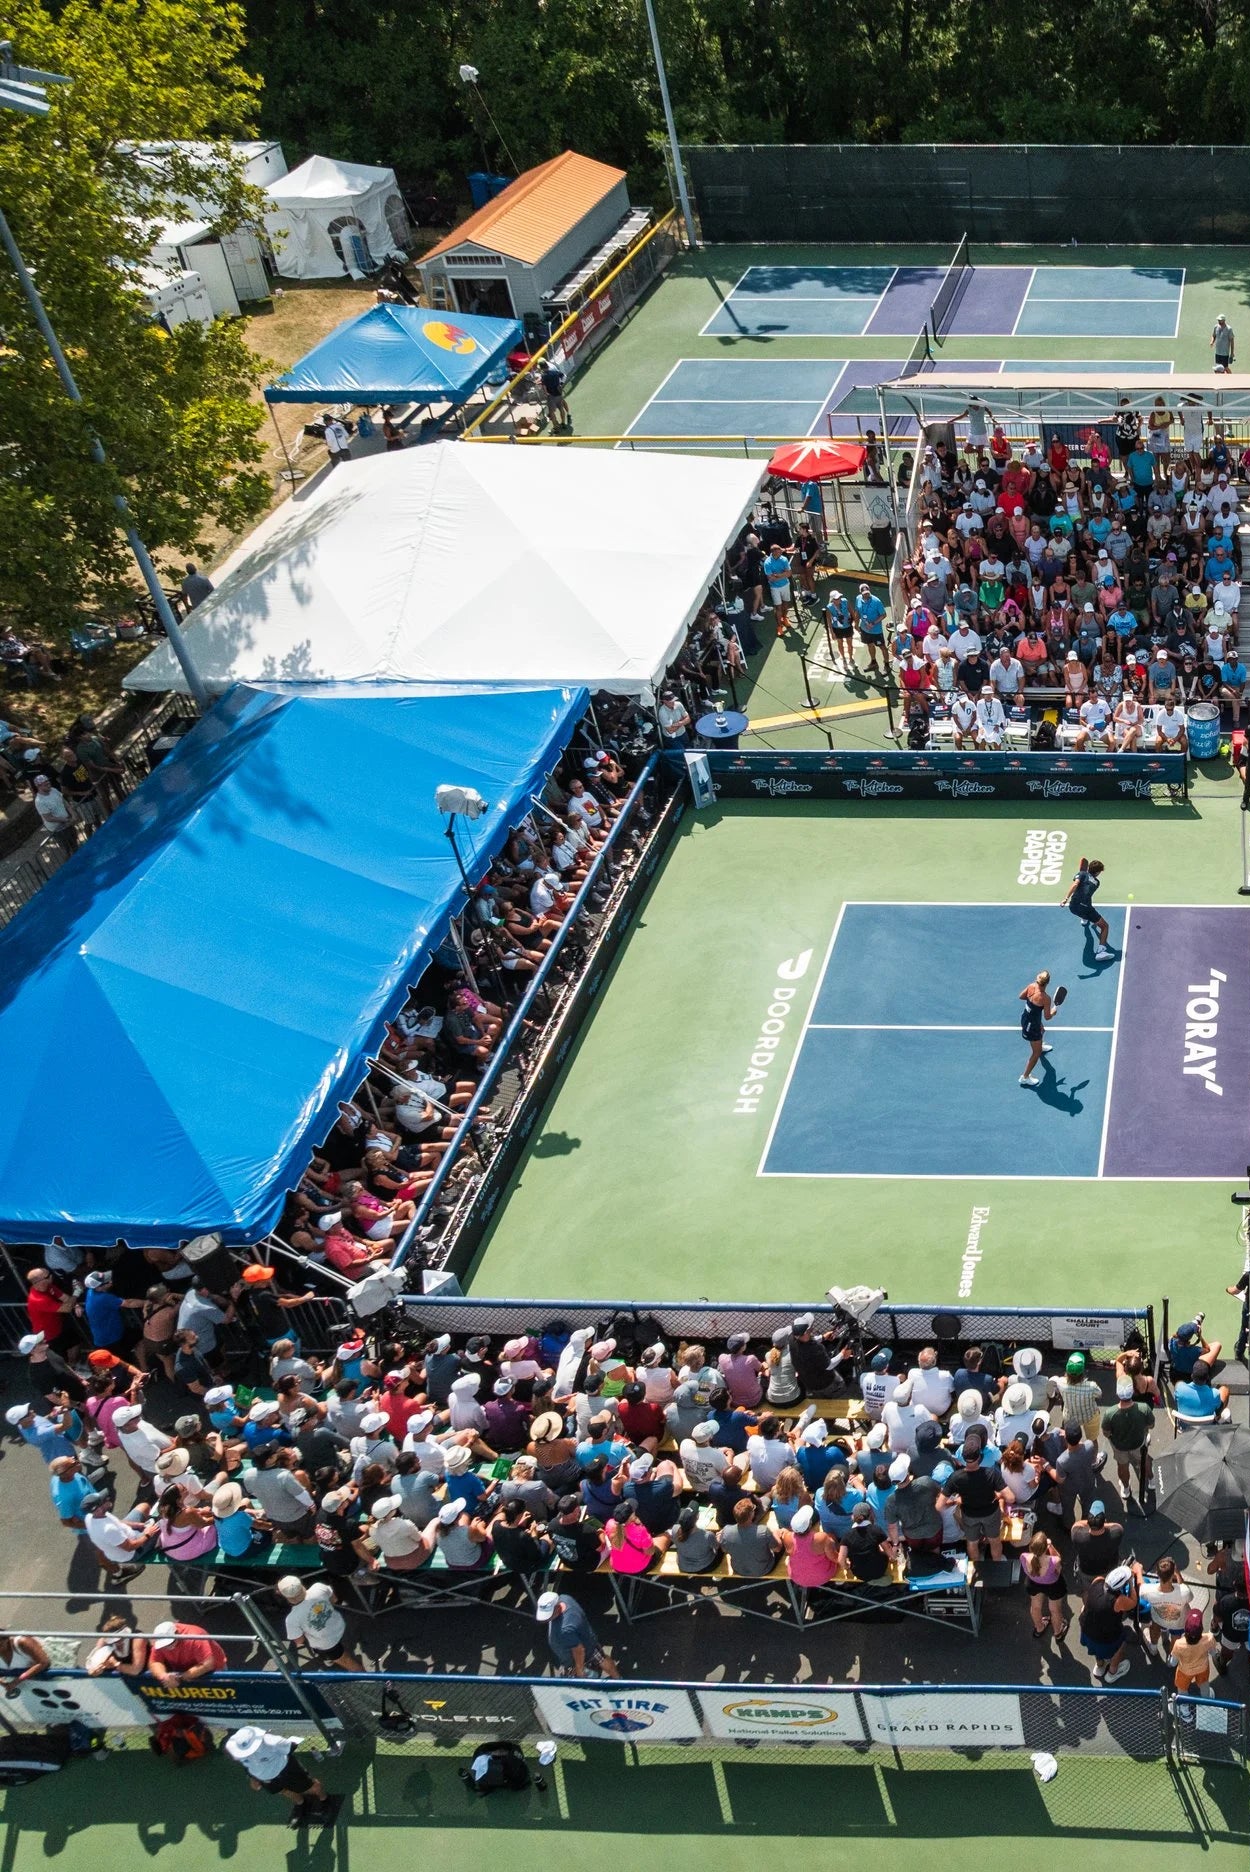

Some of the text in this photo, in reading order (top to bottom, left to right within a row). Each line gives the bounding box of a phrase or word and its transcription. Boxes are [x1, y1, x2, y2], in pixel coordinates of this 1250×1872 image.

[769, 778, 813, 796] Kitchen
[860, 778, 904, 797] Kitchen
[951, 779, 995, 798] Kitchen
[1043, 779, 1087, 798] Kitchen
[1017, 829, 1047, 886] RAPIDS
[1040, 830, 1068, 886] GRAND
[732, 987, 797, 1113] DOORDASH
[565, 1699, 670, 1714] FAT TIRE
[737, 1708, 825, 1720] KAMPS
[728, 1728, 769, 1736] National
[801, 1728, 847, 1736] Solutions
[877, 1723, 1014, 1732] GRAND RAPIDS
